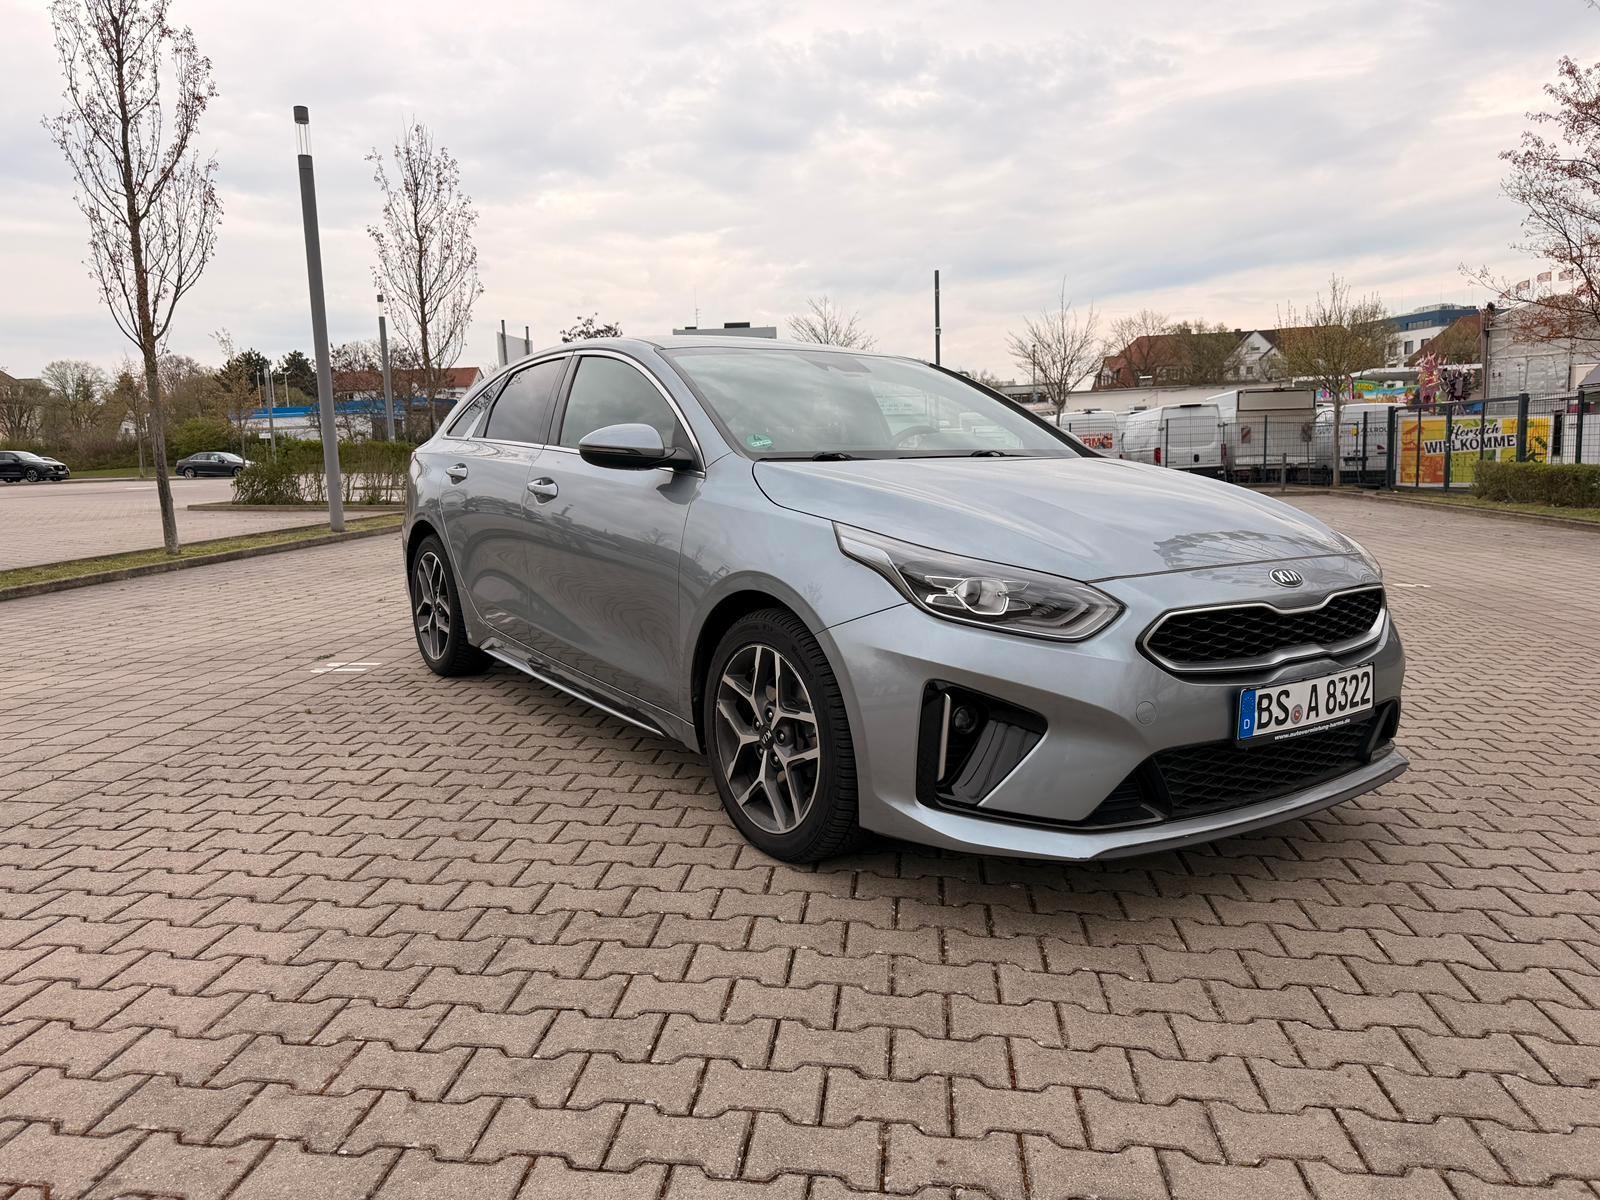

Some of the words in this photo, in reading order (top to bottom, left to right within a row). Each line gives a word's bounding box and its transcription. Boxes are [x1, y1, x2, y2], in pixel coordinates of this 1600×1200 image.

[1451, 423, 1499, 440] Herzch
[1423, 434, 1517, 454] WILKOMME
[1274, 570, 1302, 582] KIA
[1257, 689, 1290, 730] BS
[1306, 684, 1319, 720] A
[1325, 671, 1371, 715] 8322
[1243, 719, 1250, 729] D
